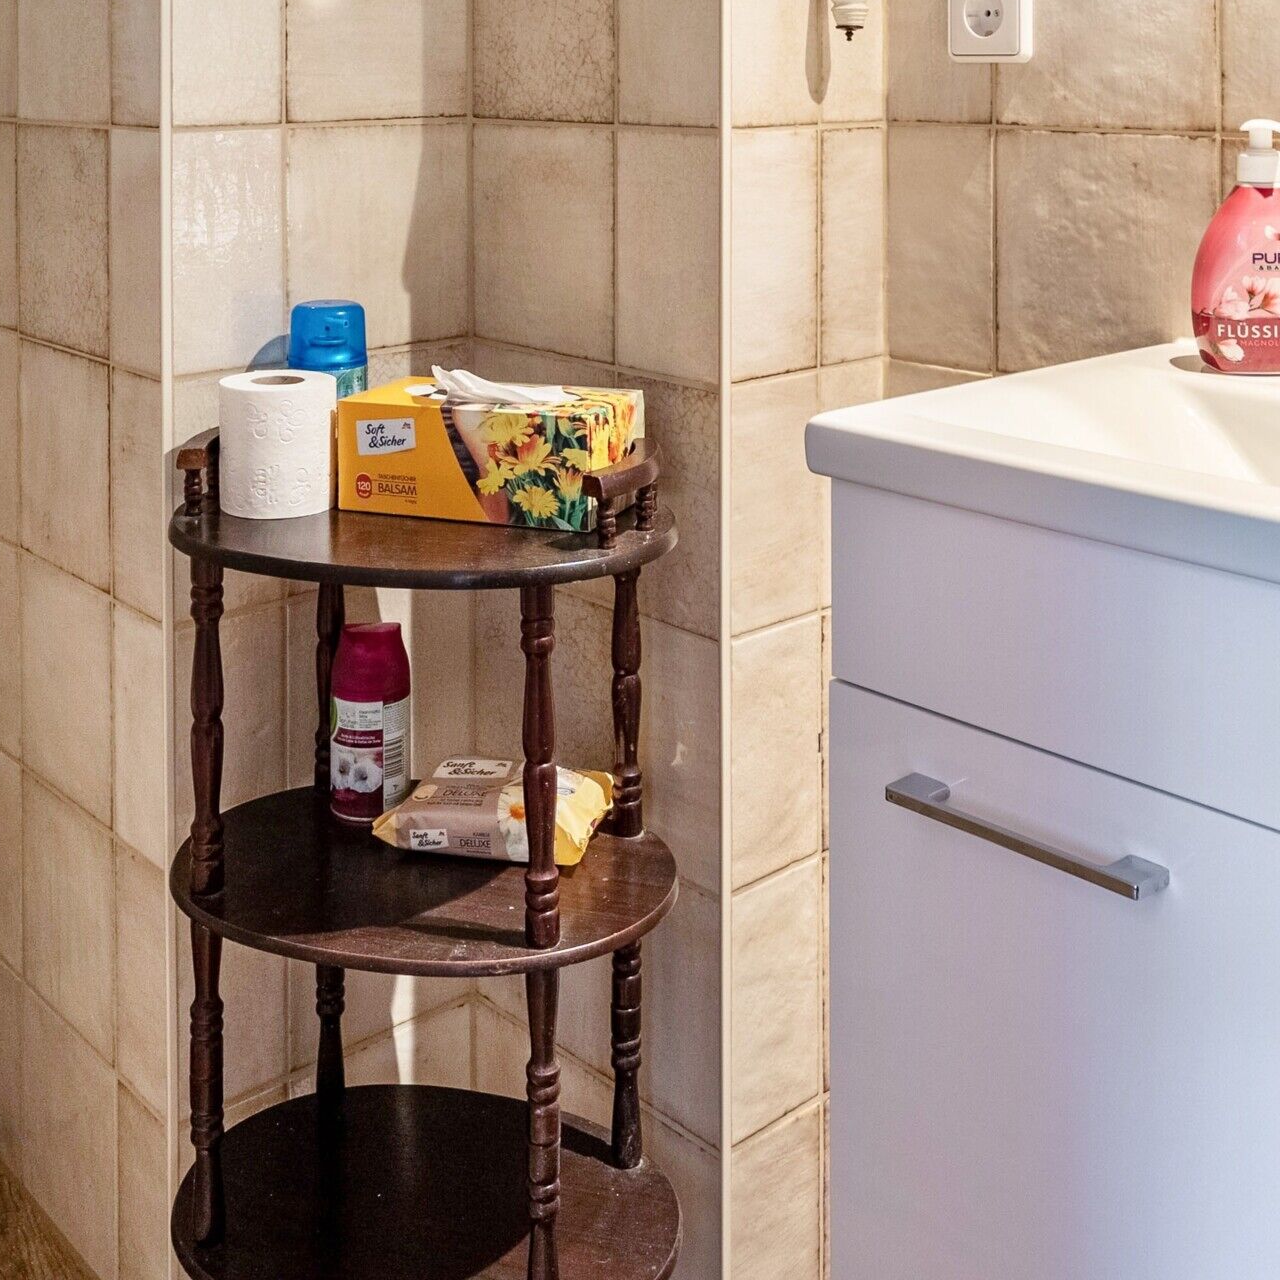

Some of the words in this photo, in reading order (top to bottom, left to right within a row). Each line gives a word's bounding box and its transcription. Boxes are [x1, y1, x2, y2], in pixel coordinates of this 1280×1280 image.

[365, 423, 385, 436] Soft
[357, 481, 371, 491] 120
[378, 482, 417, 496] BALSAM
[442, 761, 476, 769] Sanft
[412, 831, 429, 840] Sanft
[459, 838, 491, 849] DELUXE
